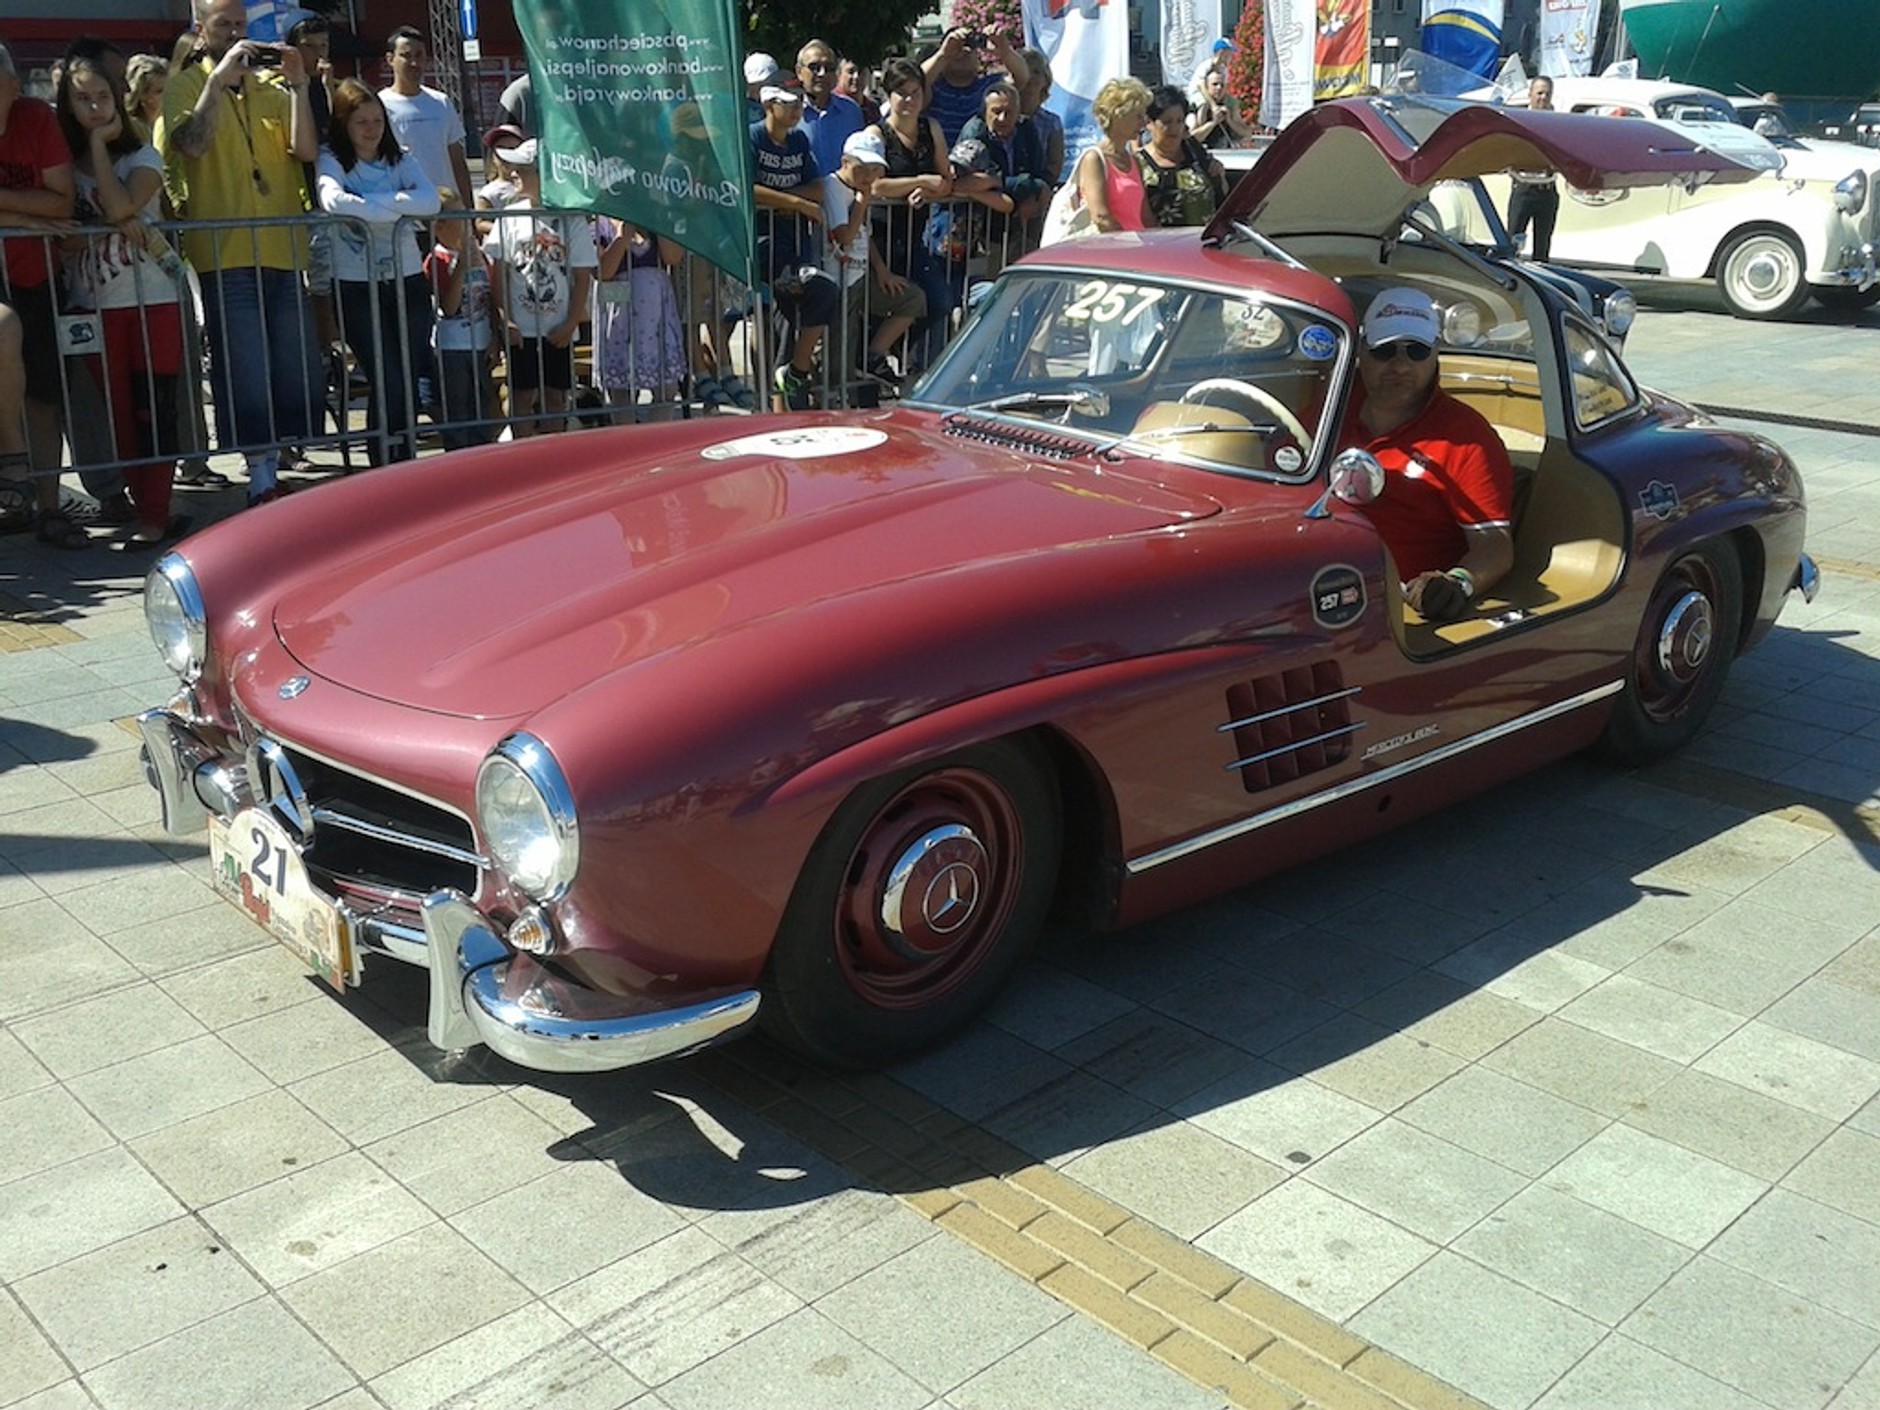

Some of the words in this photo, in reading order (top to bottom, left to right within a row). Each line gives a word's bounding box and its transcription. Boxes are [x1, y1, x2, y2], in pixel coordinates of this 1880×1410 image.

[1064, 280, 1166, 326] 257
[1320, 593, 1339, 610] 257
[251, 827, 288, 897] 21
